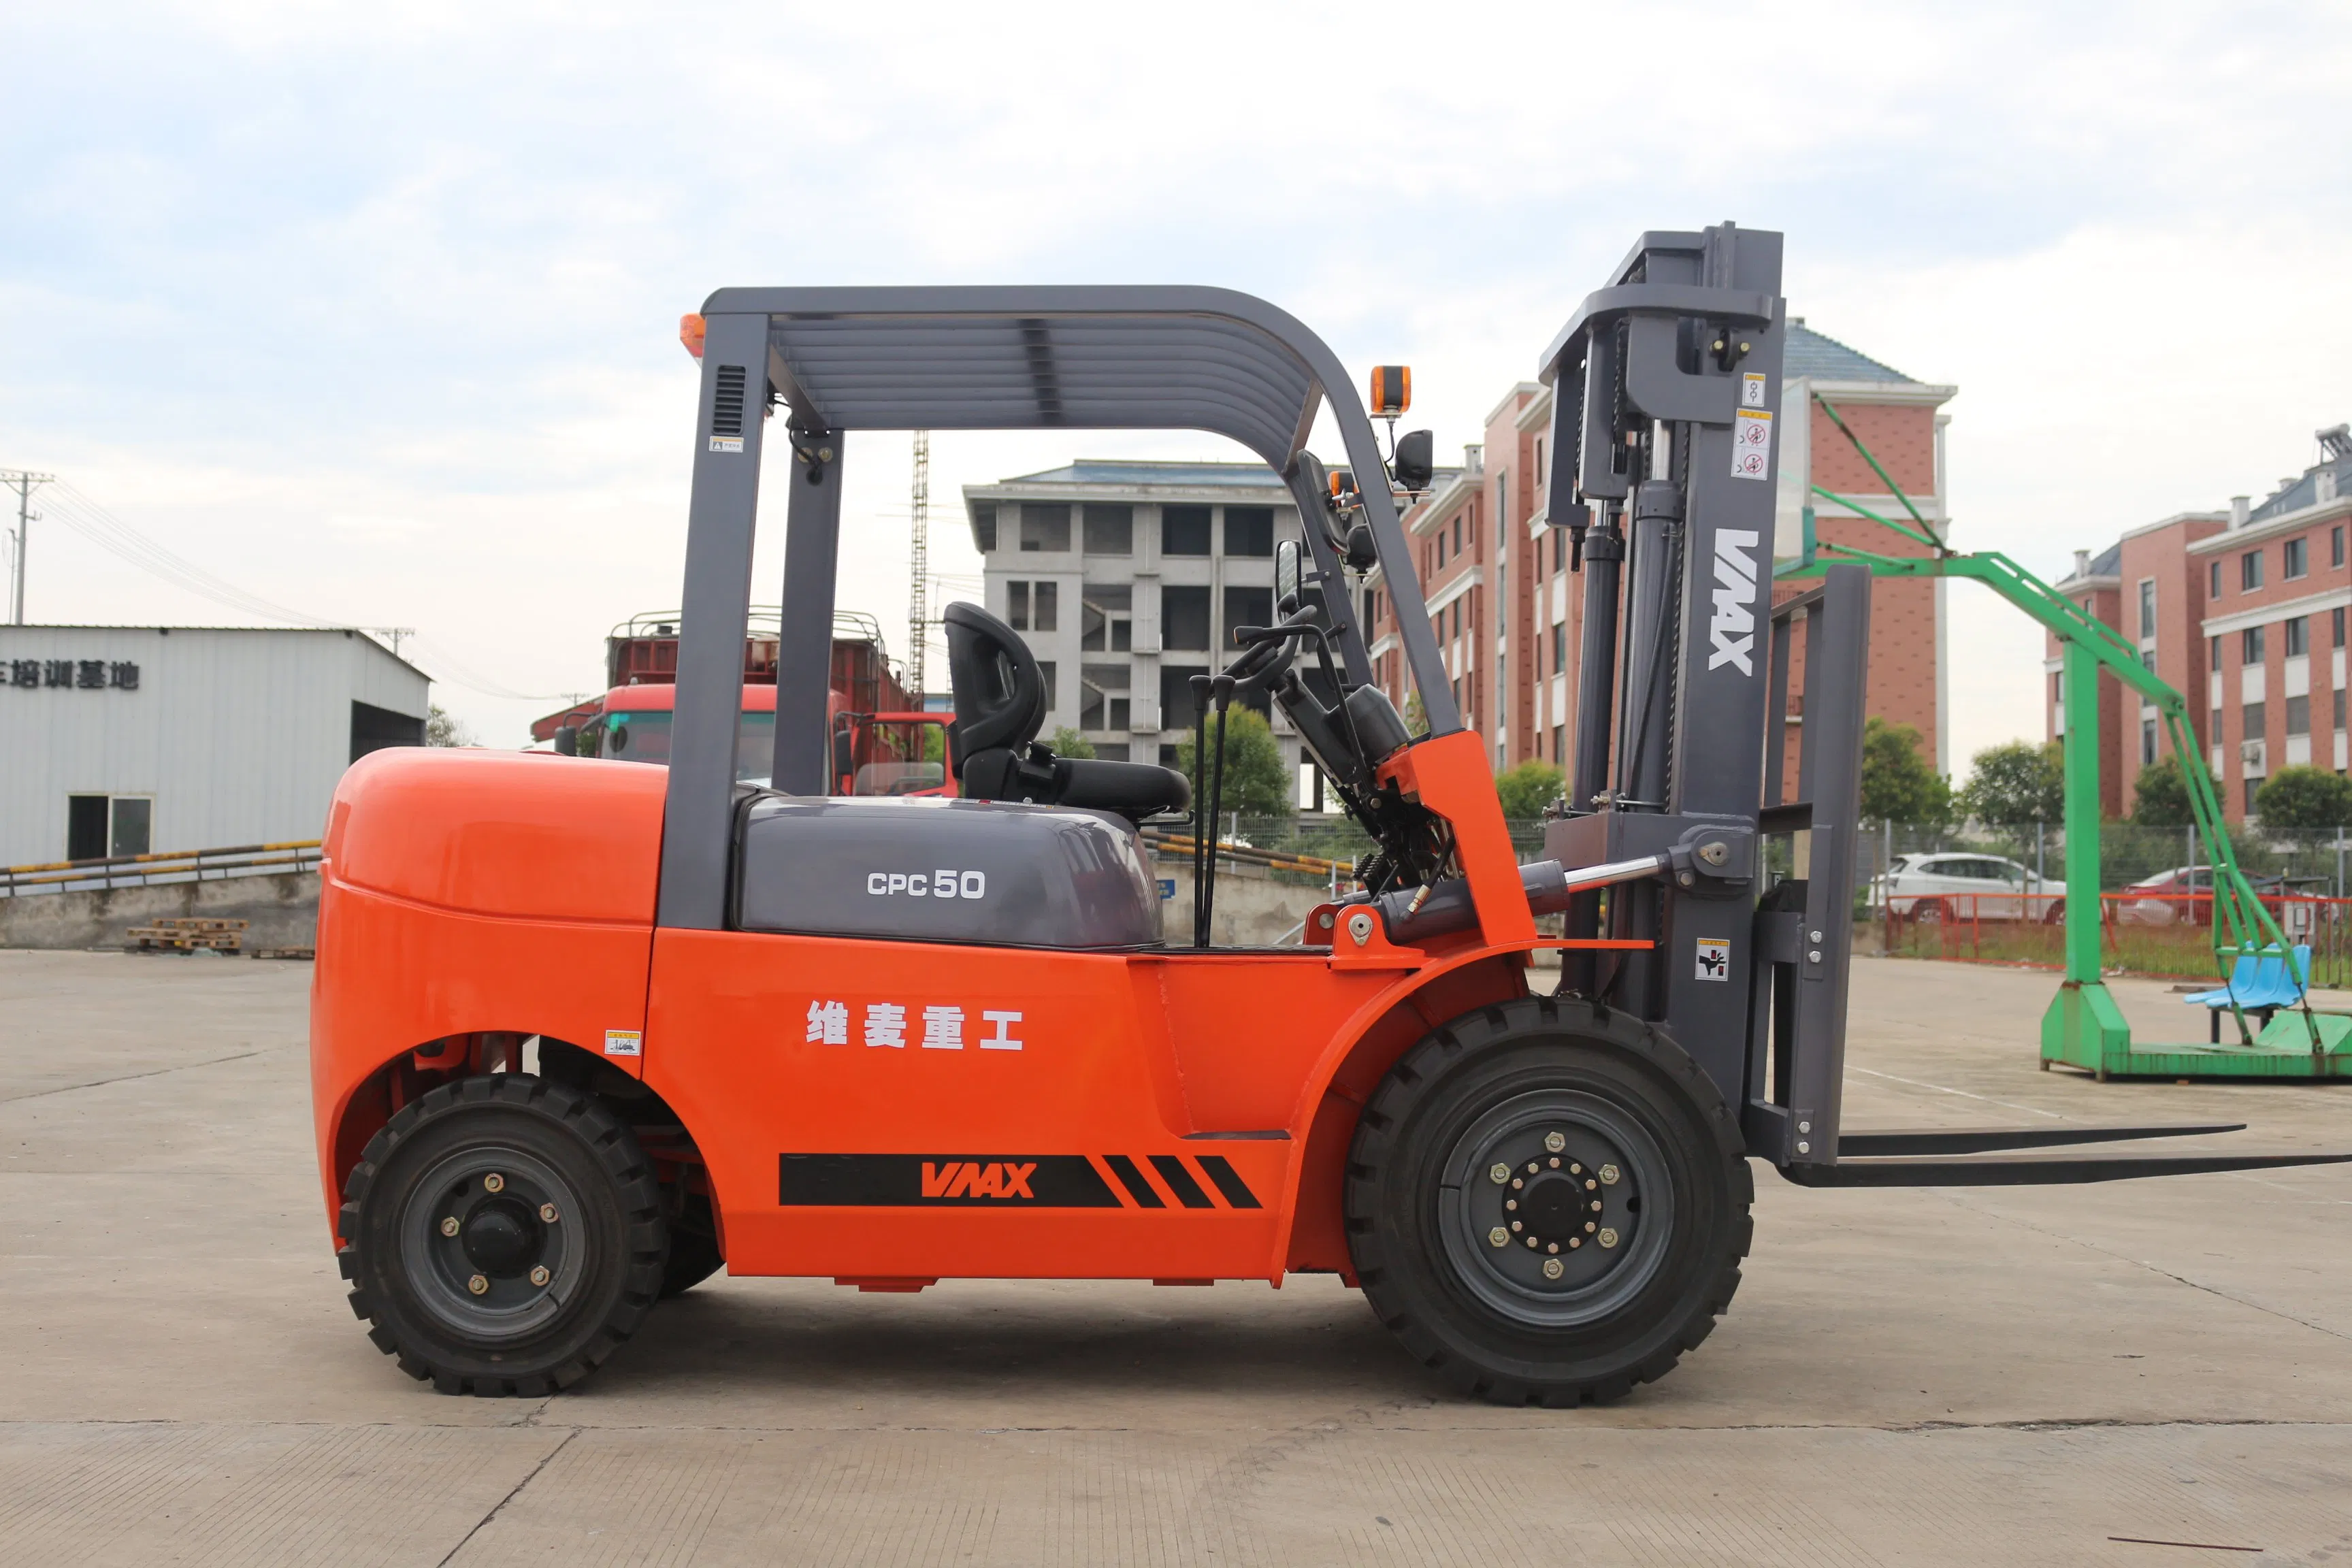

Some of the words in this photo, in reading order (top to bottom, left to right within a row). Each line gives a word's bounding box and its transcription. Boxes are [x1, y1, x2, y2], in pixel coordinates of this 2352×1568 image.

[1708, 528, 1759, 676] VMAX
[0, 659, 140, 689] 培训基地
[867, 872, 928, 896] CPC
[933, 869, 985, 899] 50
[806, 1000, 1023, 1050] 维麦重工
[921, 1162, 1038, 1198] VMAX
